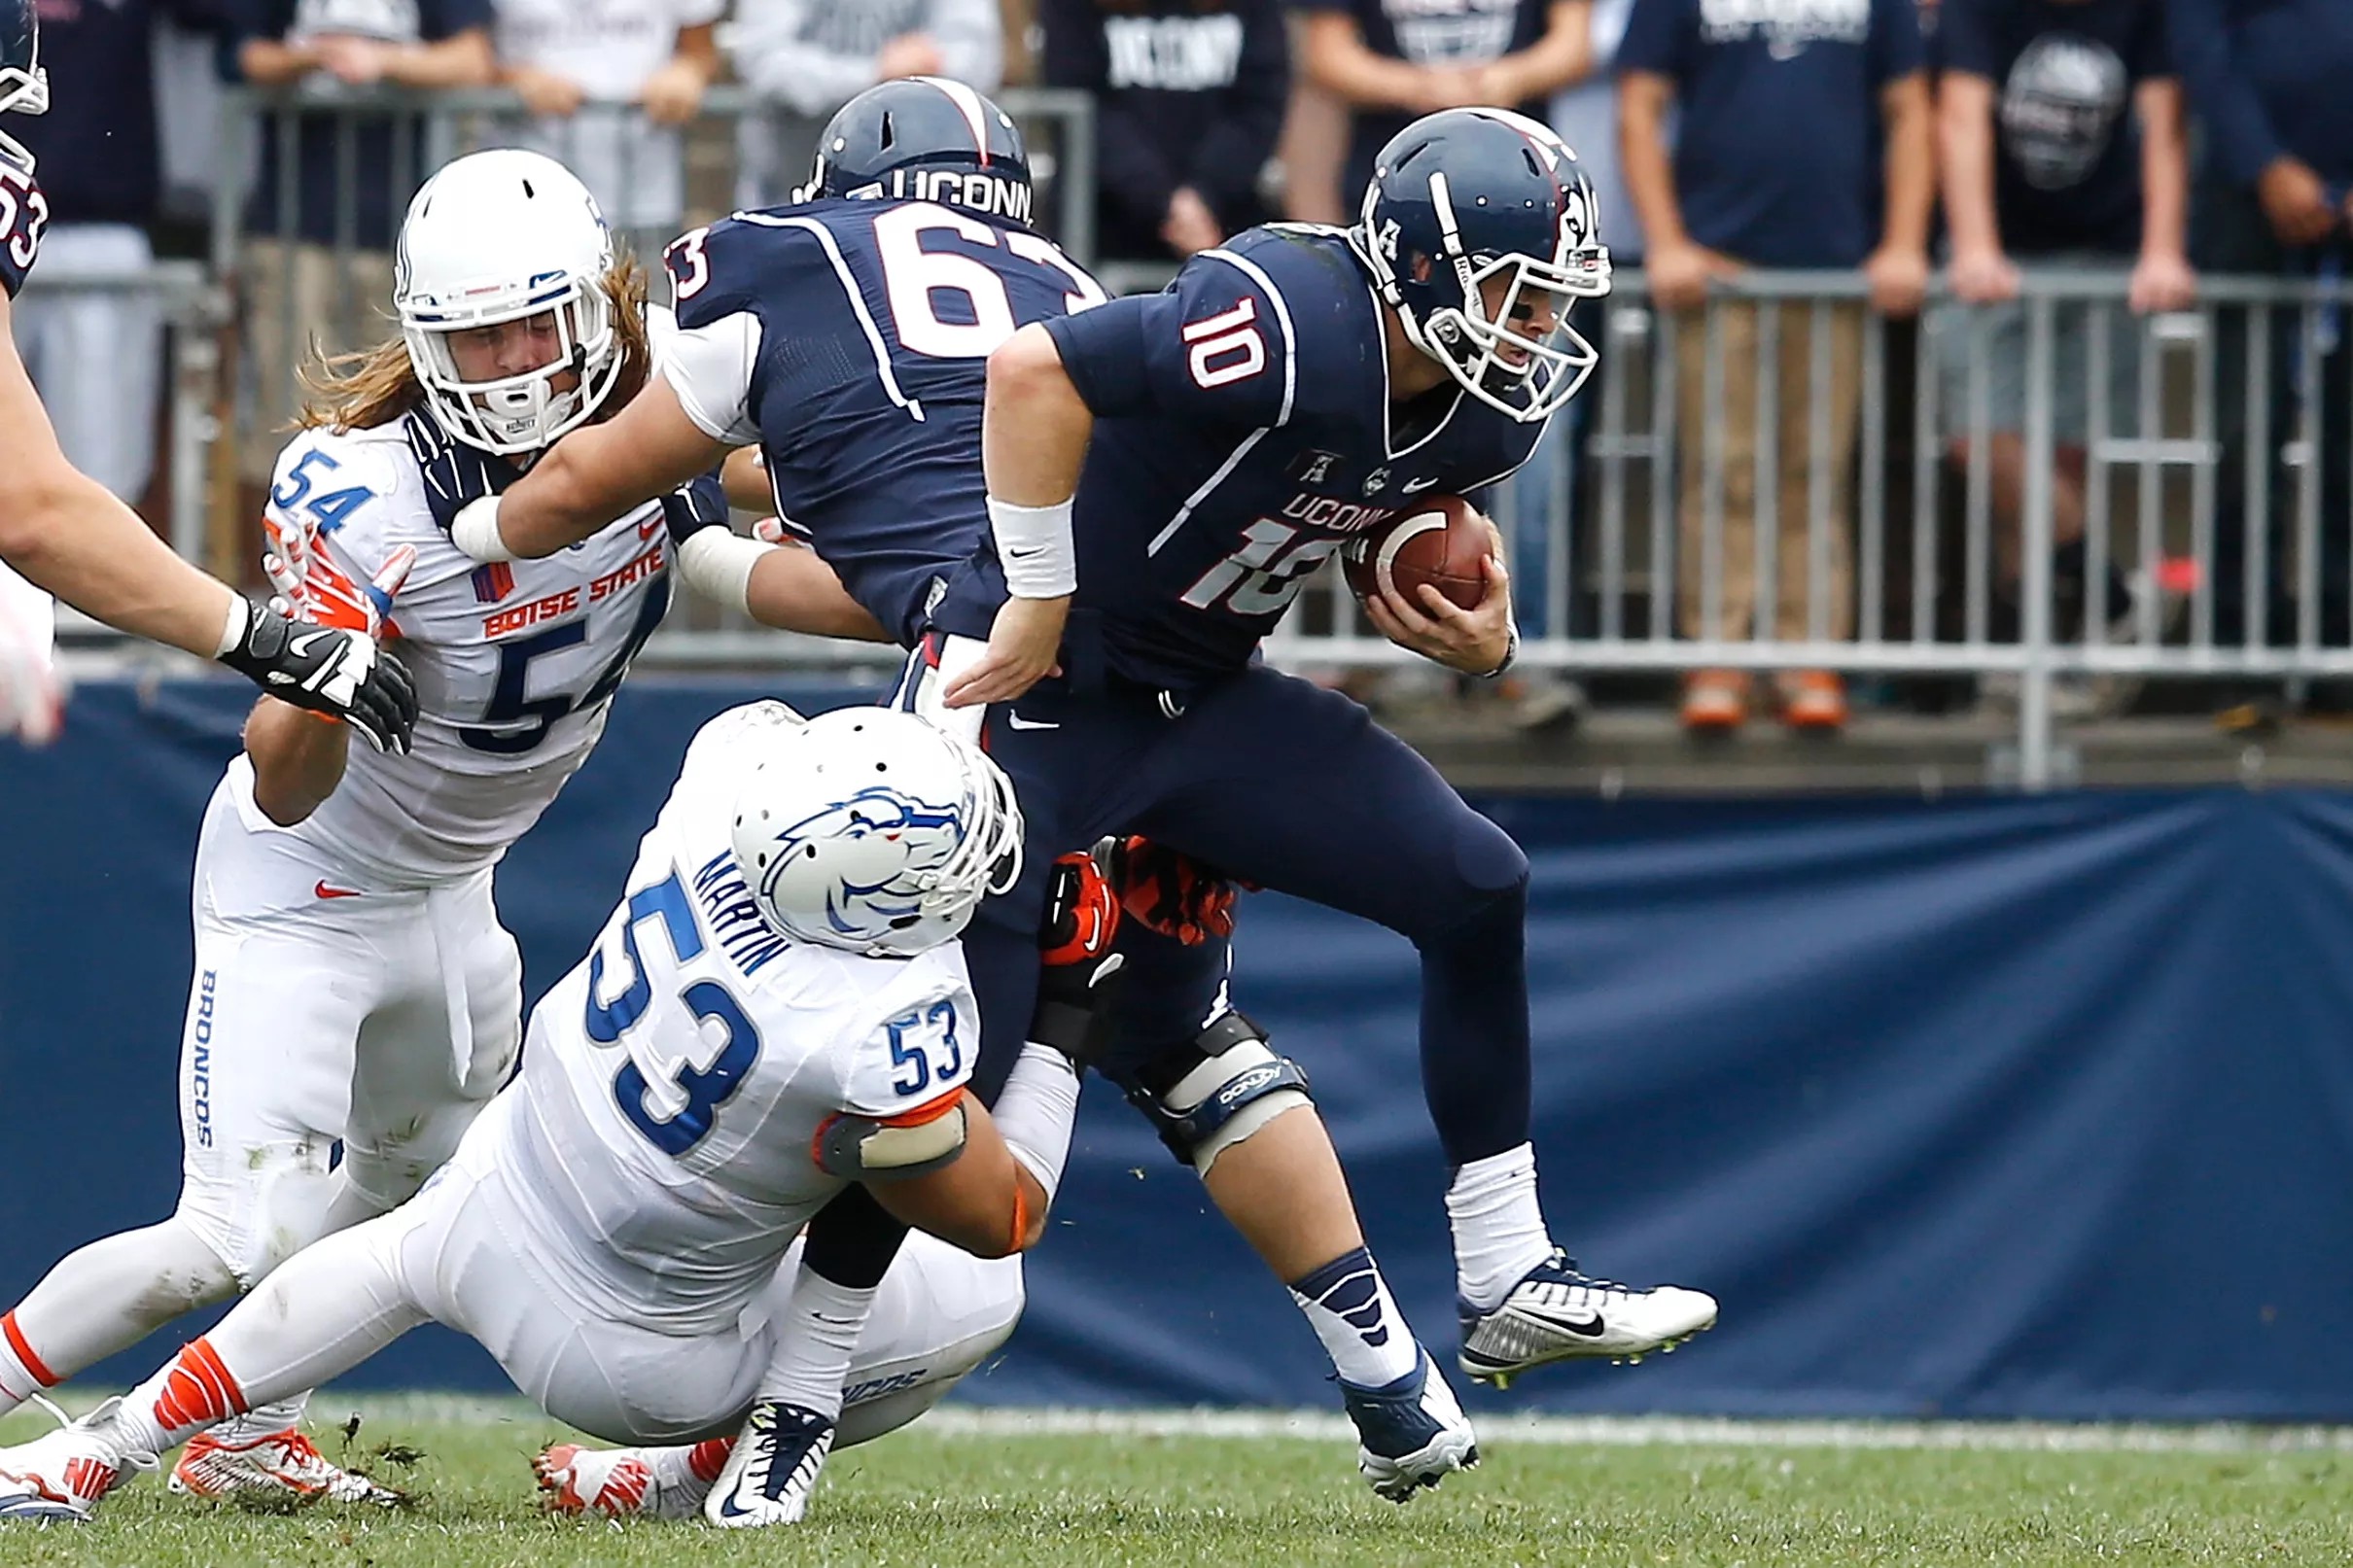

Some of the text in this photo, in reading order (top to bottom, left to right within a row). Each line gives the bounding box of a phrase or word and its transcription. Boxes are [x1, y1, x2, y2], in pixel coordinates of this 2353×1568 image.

[893, 169, 1033, 224] UCONN
[1181, 296, 1266, 389] 10
[272, 448, 377, 538] 54
[482, 545, 665, 639] BOISE STATE
[1179, 517, 1349, 615] 10
[693, 848, 791, 978] MARTIN
[584, 857, 763, 1158] 53
[885, 998, 963, 1097] 53
[193, 968, 217, 1149] BRONCOS
